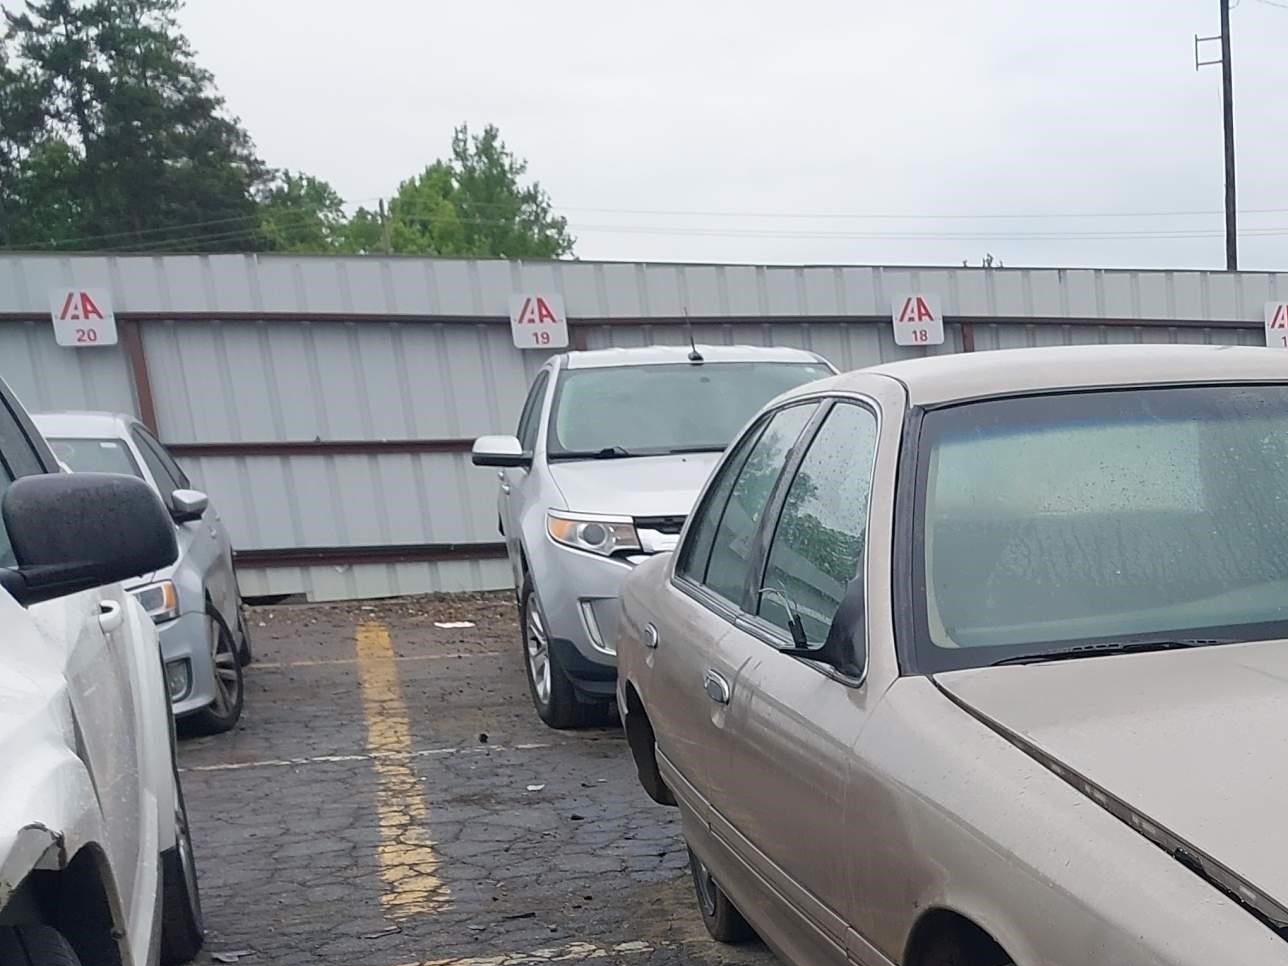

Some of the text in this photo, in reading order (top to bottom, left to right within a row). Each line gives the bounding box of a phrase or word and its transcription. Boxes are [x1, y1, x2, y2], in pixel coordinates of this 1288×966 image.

[76, 328, 97, 342] 20
[532, 331, 550, 345] 19
[912, 329, 928, 342] 18
